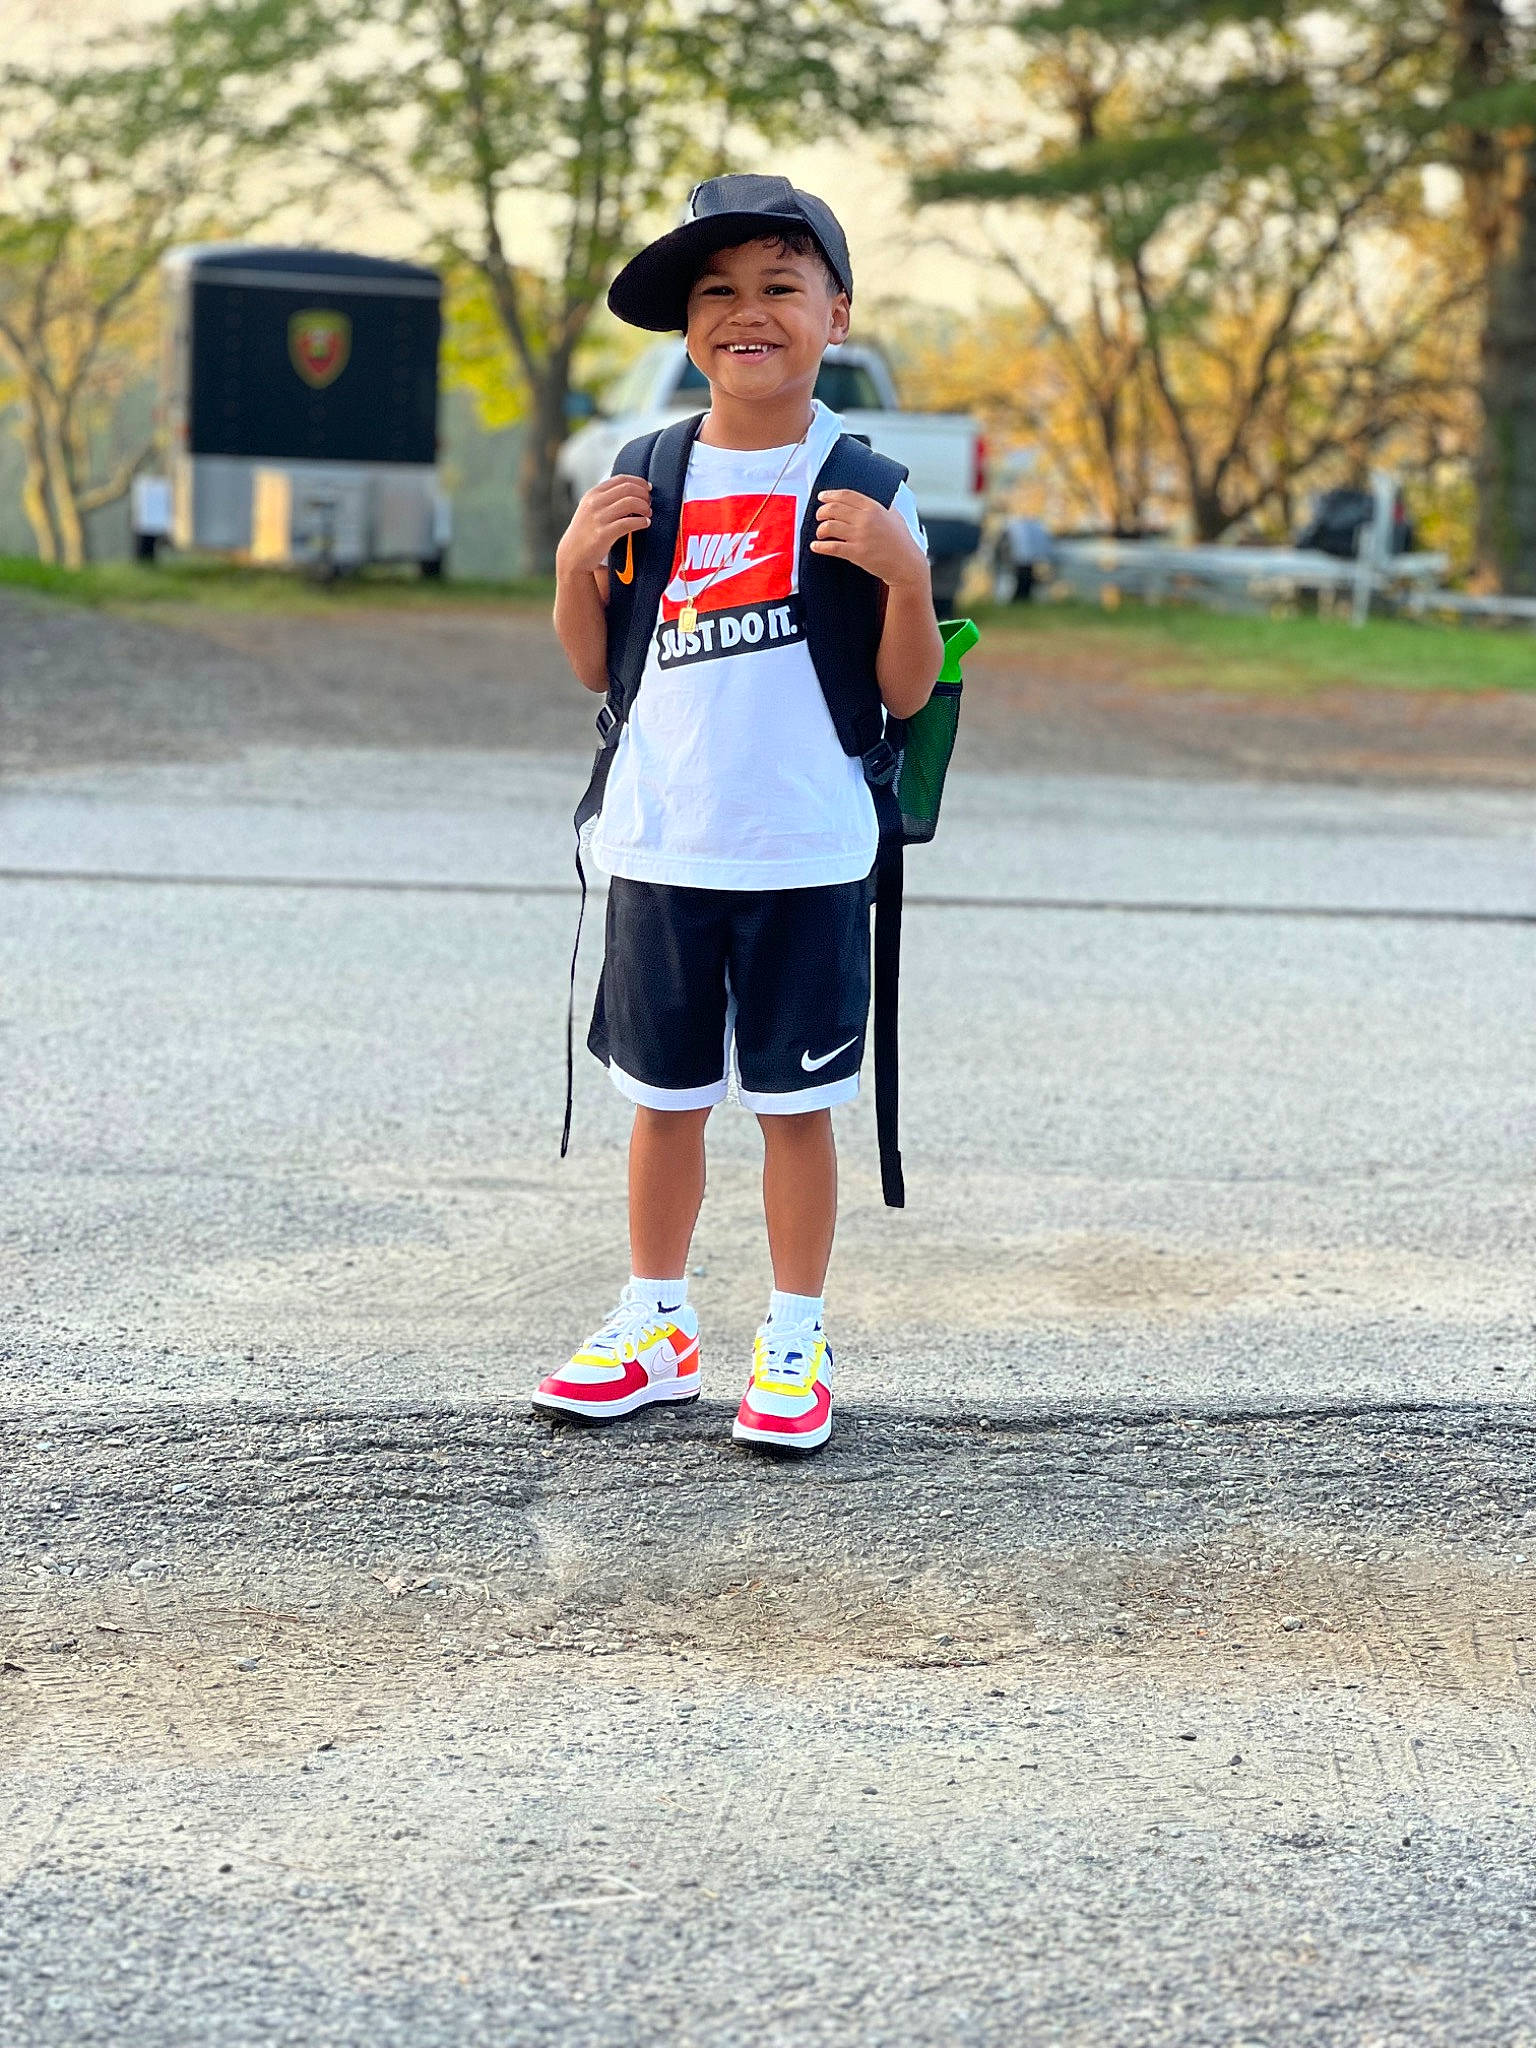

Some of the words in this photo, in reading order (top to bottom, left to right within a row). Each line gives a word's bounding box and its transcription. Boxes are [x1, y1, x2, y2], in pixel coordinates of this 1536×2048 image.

[685, 531, 759, 570] NIKE
[661, 619, 715, 661] JUST
[720, 612, 764, 648] DO
[768, 605, 798, 639] IT.
